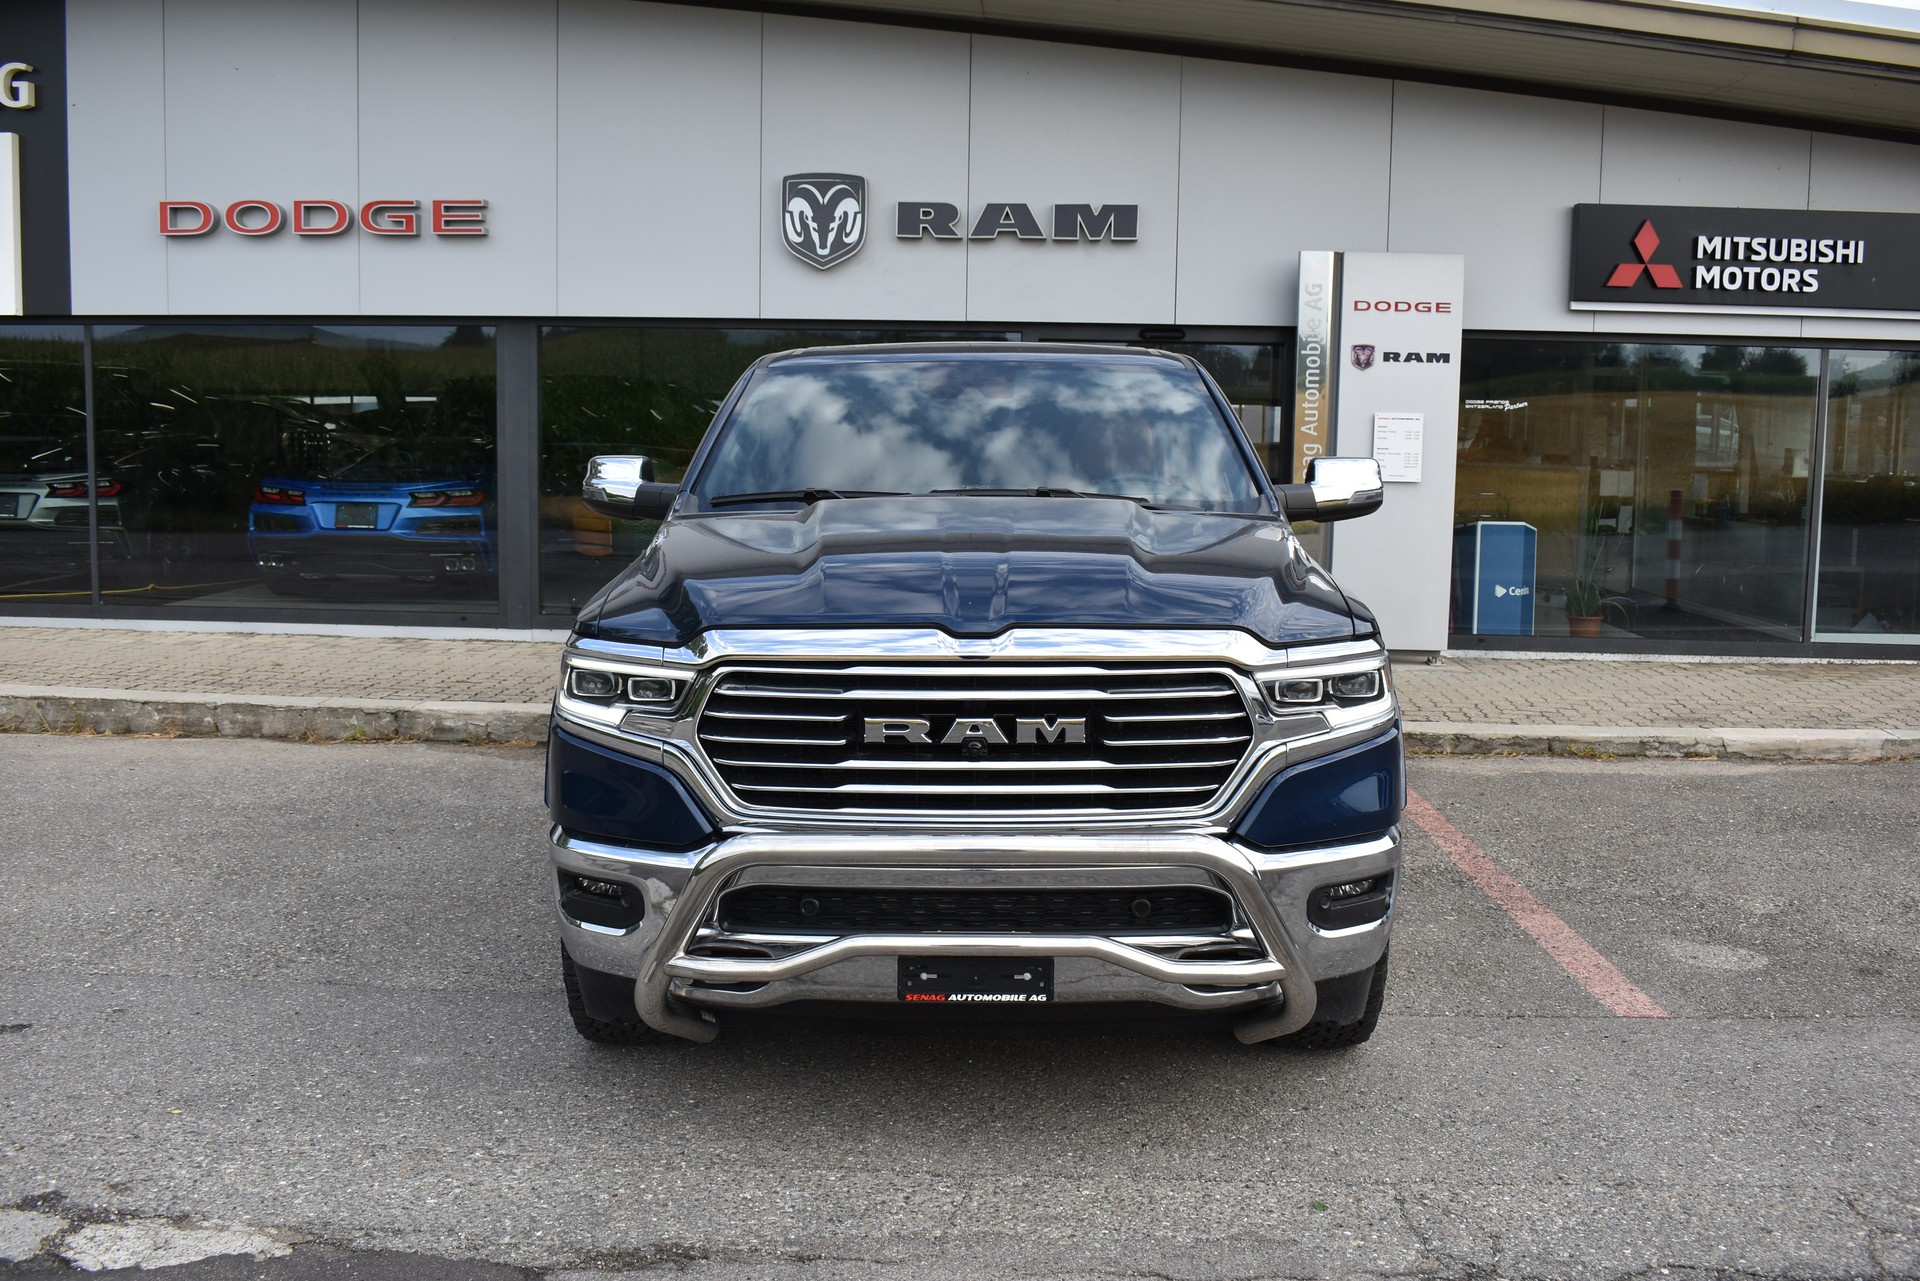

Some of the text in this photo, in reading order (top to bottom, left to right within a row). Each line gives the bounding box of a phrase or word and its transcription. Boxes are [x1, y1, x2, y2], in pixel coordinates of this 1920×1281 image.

[158, 199, 488, 237] DODGE
[896, 201, 1139, 241] RAM
[1697, 235, 1864, 264] MITSUBISHI
[1695, 265, 1818, 293] MOTORS
[1304, 283, 1323, 312] AG
[1353, 300, 1452, 314] DODGE
[1382, 351, 1451, 364] RAM
[1300, 316, 1321, 435] Automobile
[863, 717, 1086, 744] RAM
[905, 993, 1047, 1002] SENAG AUTOMOBILE AG
